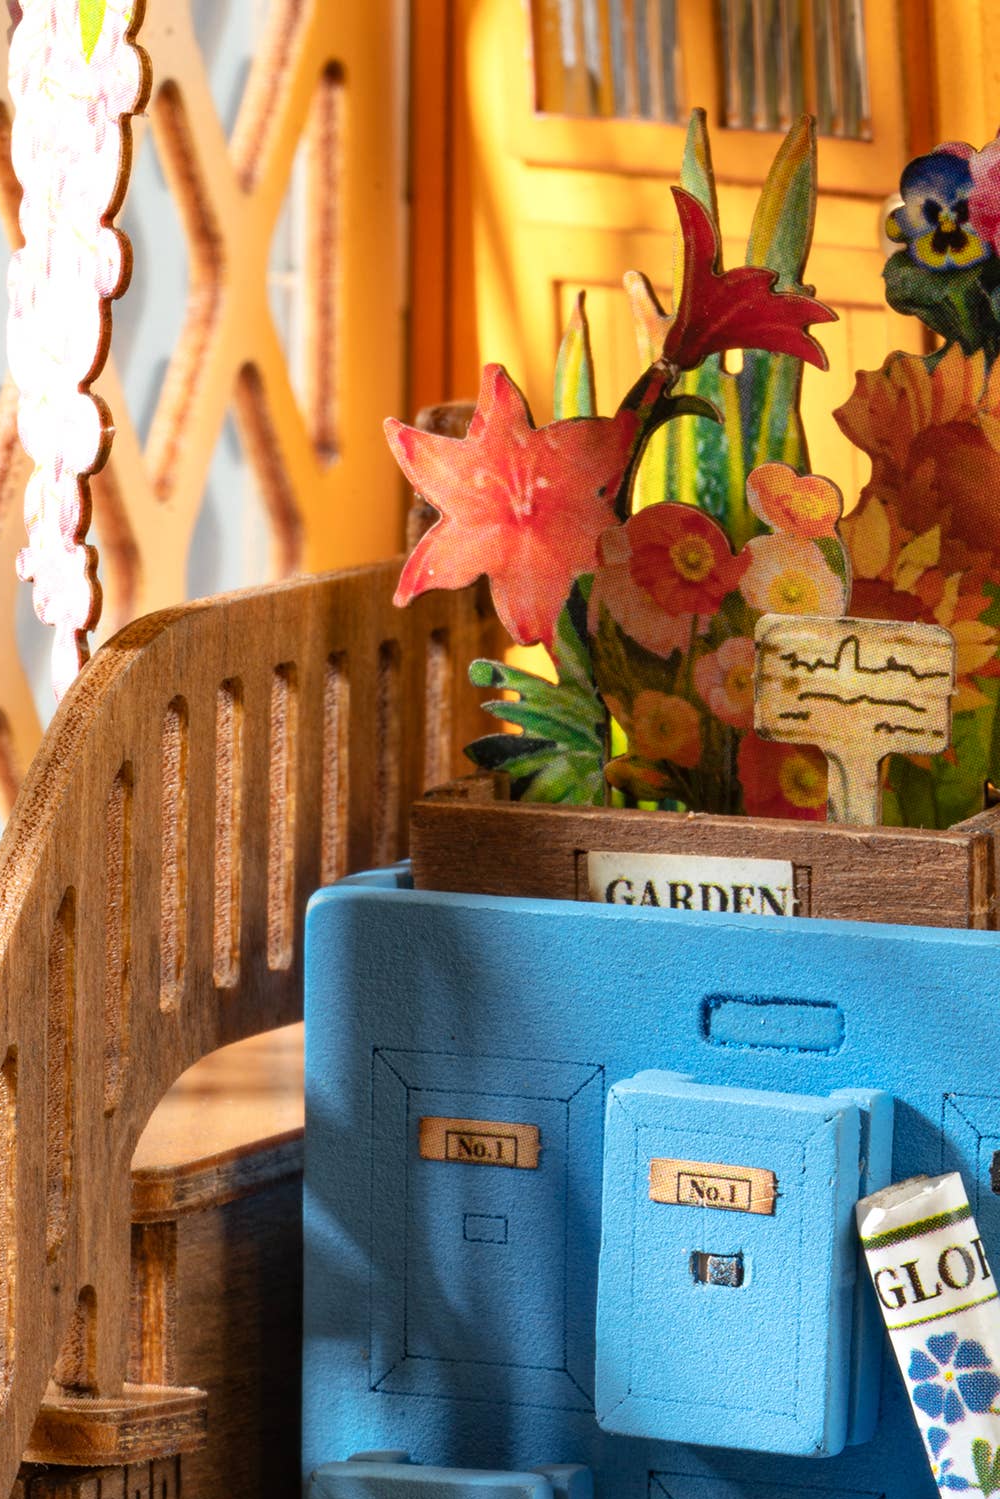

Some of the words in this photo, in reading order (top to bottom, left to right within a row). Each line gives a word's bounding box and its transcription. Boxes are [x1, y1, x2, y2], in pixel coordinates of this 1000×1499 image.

[604, 876, 792, 917] GARDEN
[457, 1135, 503, 1160] No.1
[688, 1179, 737, 1203] No.1
